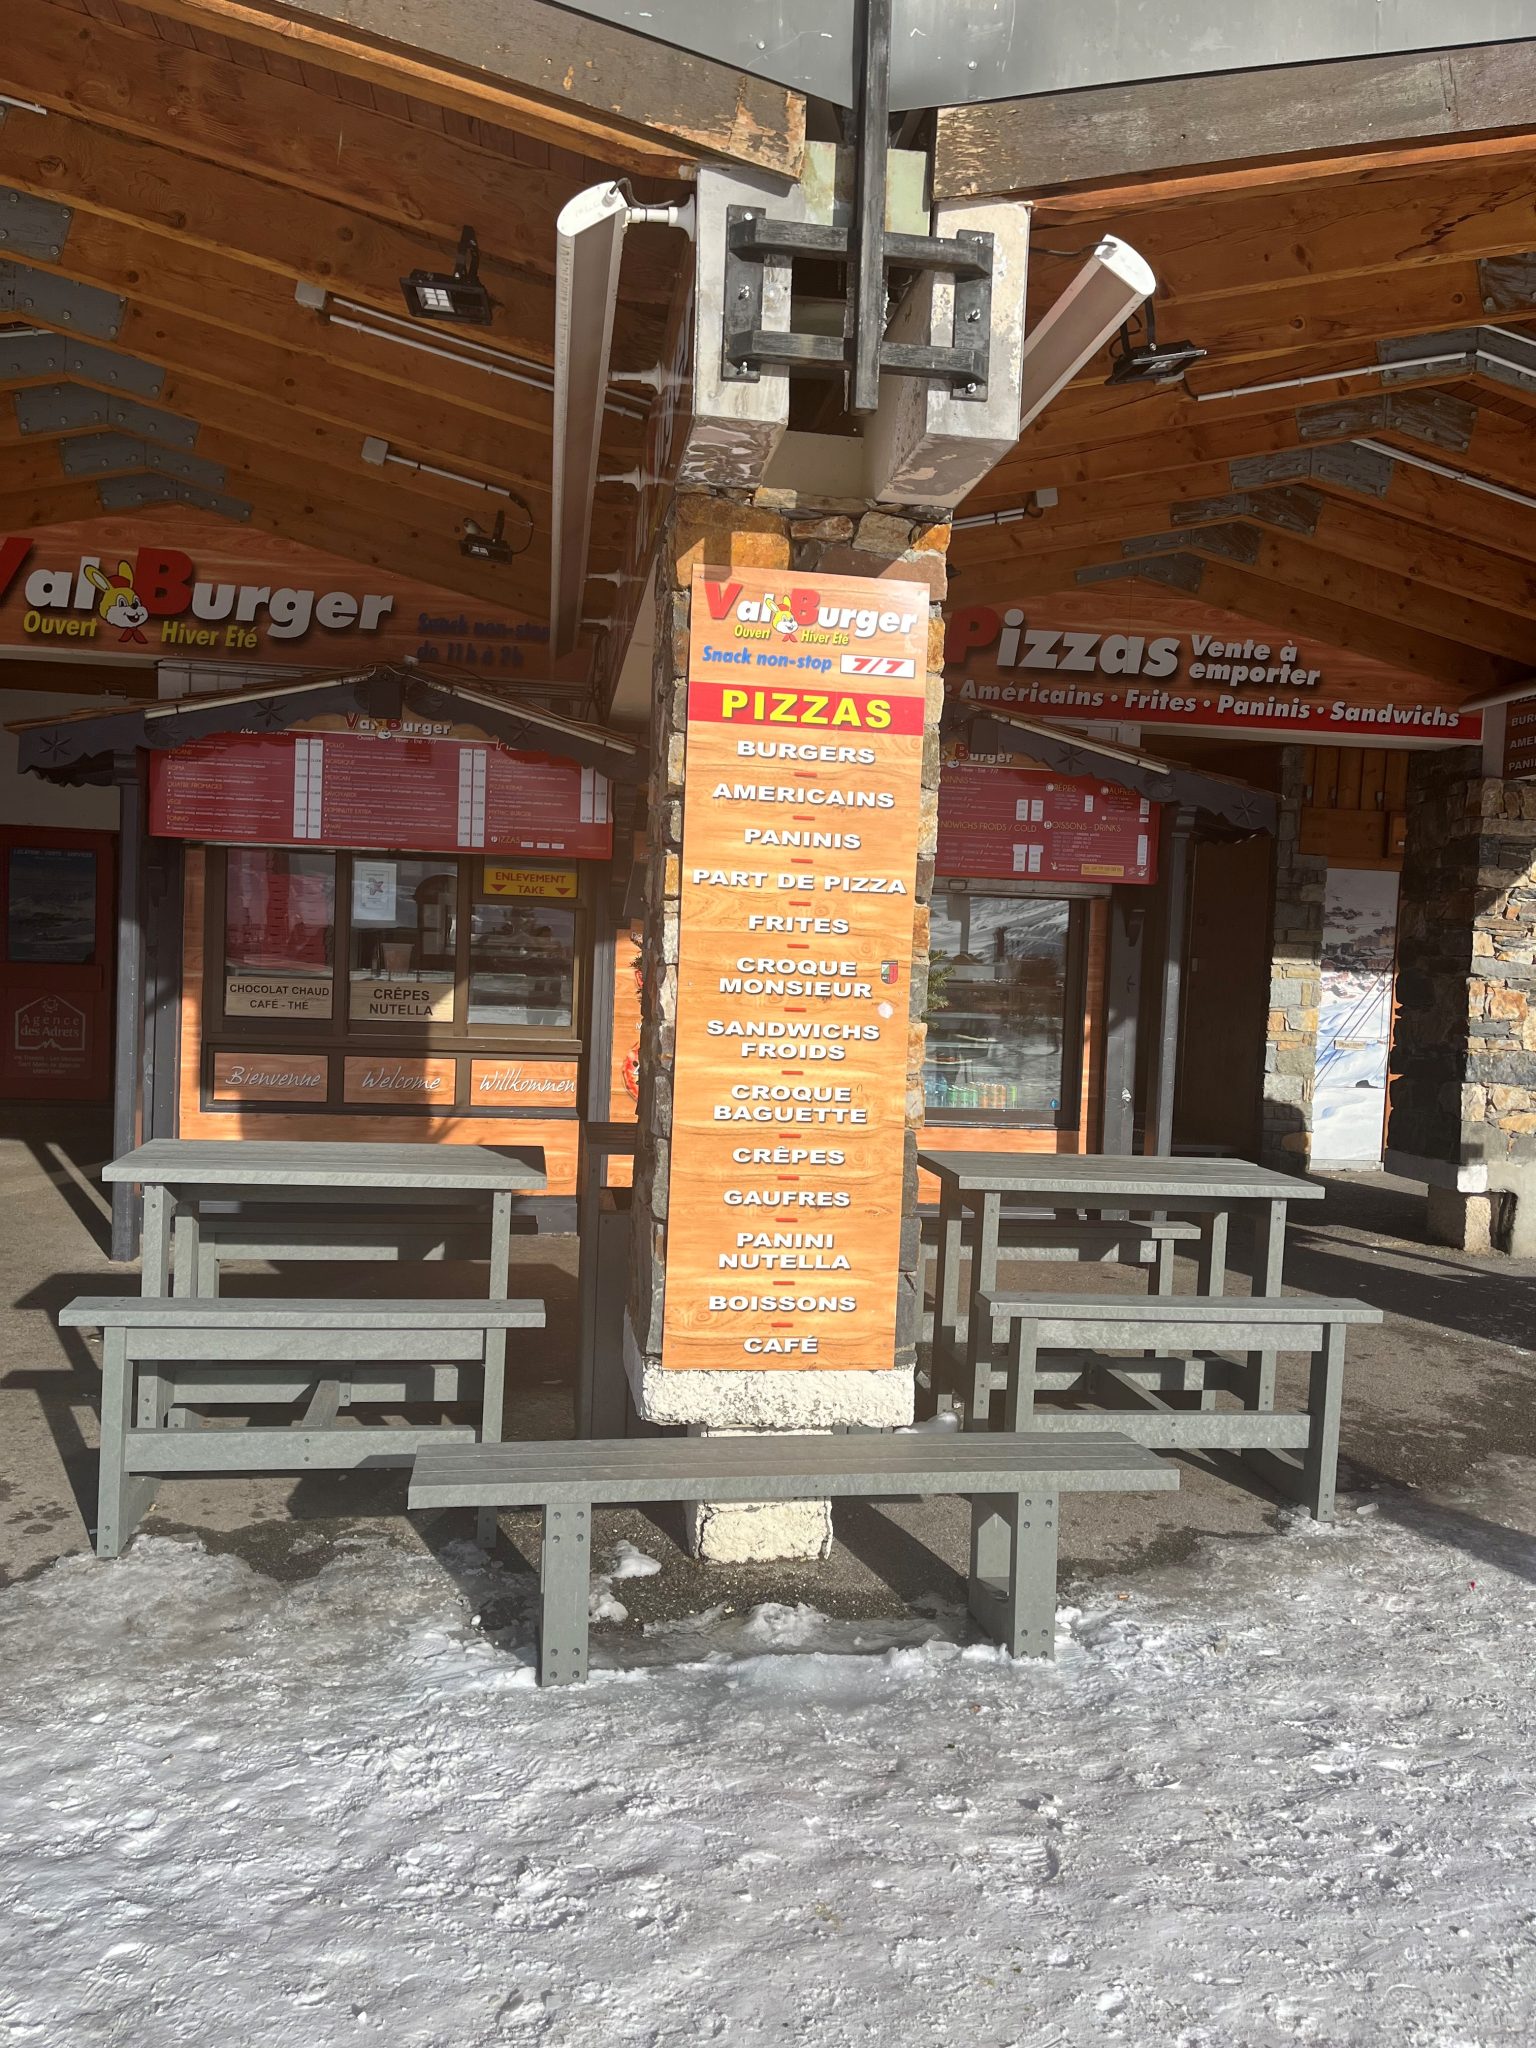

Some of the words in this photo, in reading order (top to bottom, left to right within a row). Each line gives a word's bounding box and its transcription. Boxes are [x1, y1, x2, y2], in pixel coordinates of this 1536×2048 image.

[136, 547, 394, 639] Burger
[705, 581, 774, 624] Val
[791, 588, 919, 639] Burger
[23, 610, 99, 637] Ouvert
[161, 620, 219, 647] Hiver
[225, 624, 259, 649] Eté
[734, 624, 771, 641] Ouvert
[801, 629, 830, 644] Hiver
[831, 634, 850, 646] Eté
[943, 606, 1181, 678] Pizzas
[1191, 634, 1272, 662] Vente
[1279, 640, 1299, 663] à
[702, 645, 752, 665] Snack
[757, 649, 832, 673] non-stop
[851, 657, 905, 674] 7/7
[1188, 661, 1321, 687] emporter
[722, 689, 892, 729] PIZZAS
[959, 679, 1104, 707] Américains
[1124, 689, 1197, 713] Frites
[1217, 694, 1311, 720] Paninis
[1329, 701, 1460, 728] Sandwichs
[1511, 713, 1536, 728] BUR
[737, 740, 876, 765] BURGERS
[1509, 734, 1536, 750] AME
[955, 743, 1013, 764] Burger
[1508, 760, 1536, 773] PANI
[712, 782, 895, 809] AMERICAINS
[940, 820, 978, 830] NDWICHS
[979, 822, 1007, 832] FROIDS
[1014, 824, 1037, 833] COLD
[1094, 823, 1122, 833] DRINKS
[744, 828, 861, 850] PANINIS
[495, 871, 566, 884] ENLEVEMENT
[692, 869, 768, 887] PART
[777, 872, 814, 889] DE
[823, 875, 907, 895] PIZZA
[518, 885, 545, 895] TAKE
[748, 914, 850, 935] FRITES
[736, 957, 858, 978] CROQUE
[229, 984, 288, 995] CHOCOLAT
[291, 986, 330, 996] CHAUD
[719, 976, 873, 998] MONSIEUR
[249, 998, 278, 1009] CAFÉ
[287, 1000, 309, 1010] THÉ
[369, 1003, 433, 1016] NUTELLA
[706, 1019, 880, 1042] SANDWICHS
[740, 1042, 846, 1061] FROIDS
[225, 1065, 322, 1088] Bienvenue
[361, 1066, 441, 1091] Welcome
[479, 1068, 576, 1094] Willkommen
[731, 1084, 852, 1104] CROQUE
[713, 1105, 869, 1125] BAGUETTE
[732, 1146, 846, 1166] CRÊPES
[723, 1190, 851, 1209] GAUFRES
[736, 1232, 834, 1250] PANINI
[717, 1254, 851, 1271] NUTELLA
[708, 1295, 857, 1313] BOISSONS
[743, 1336, 819, 1355] CAFÉ
